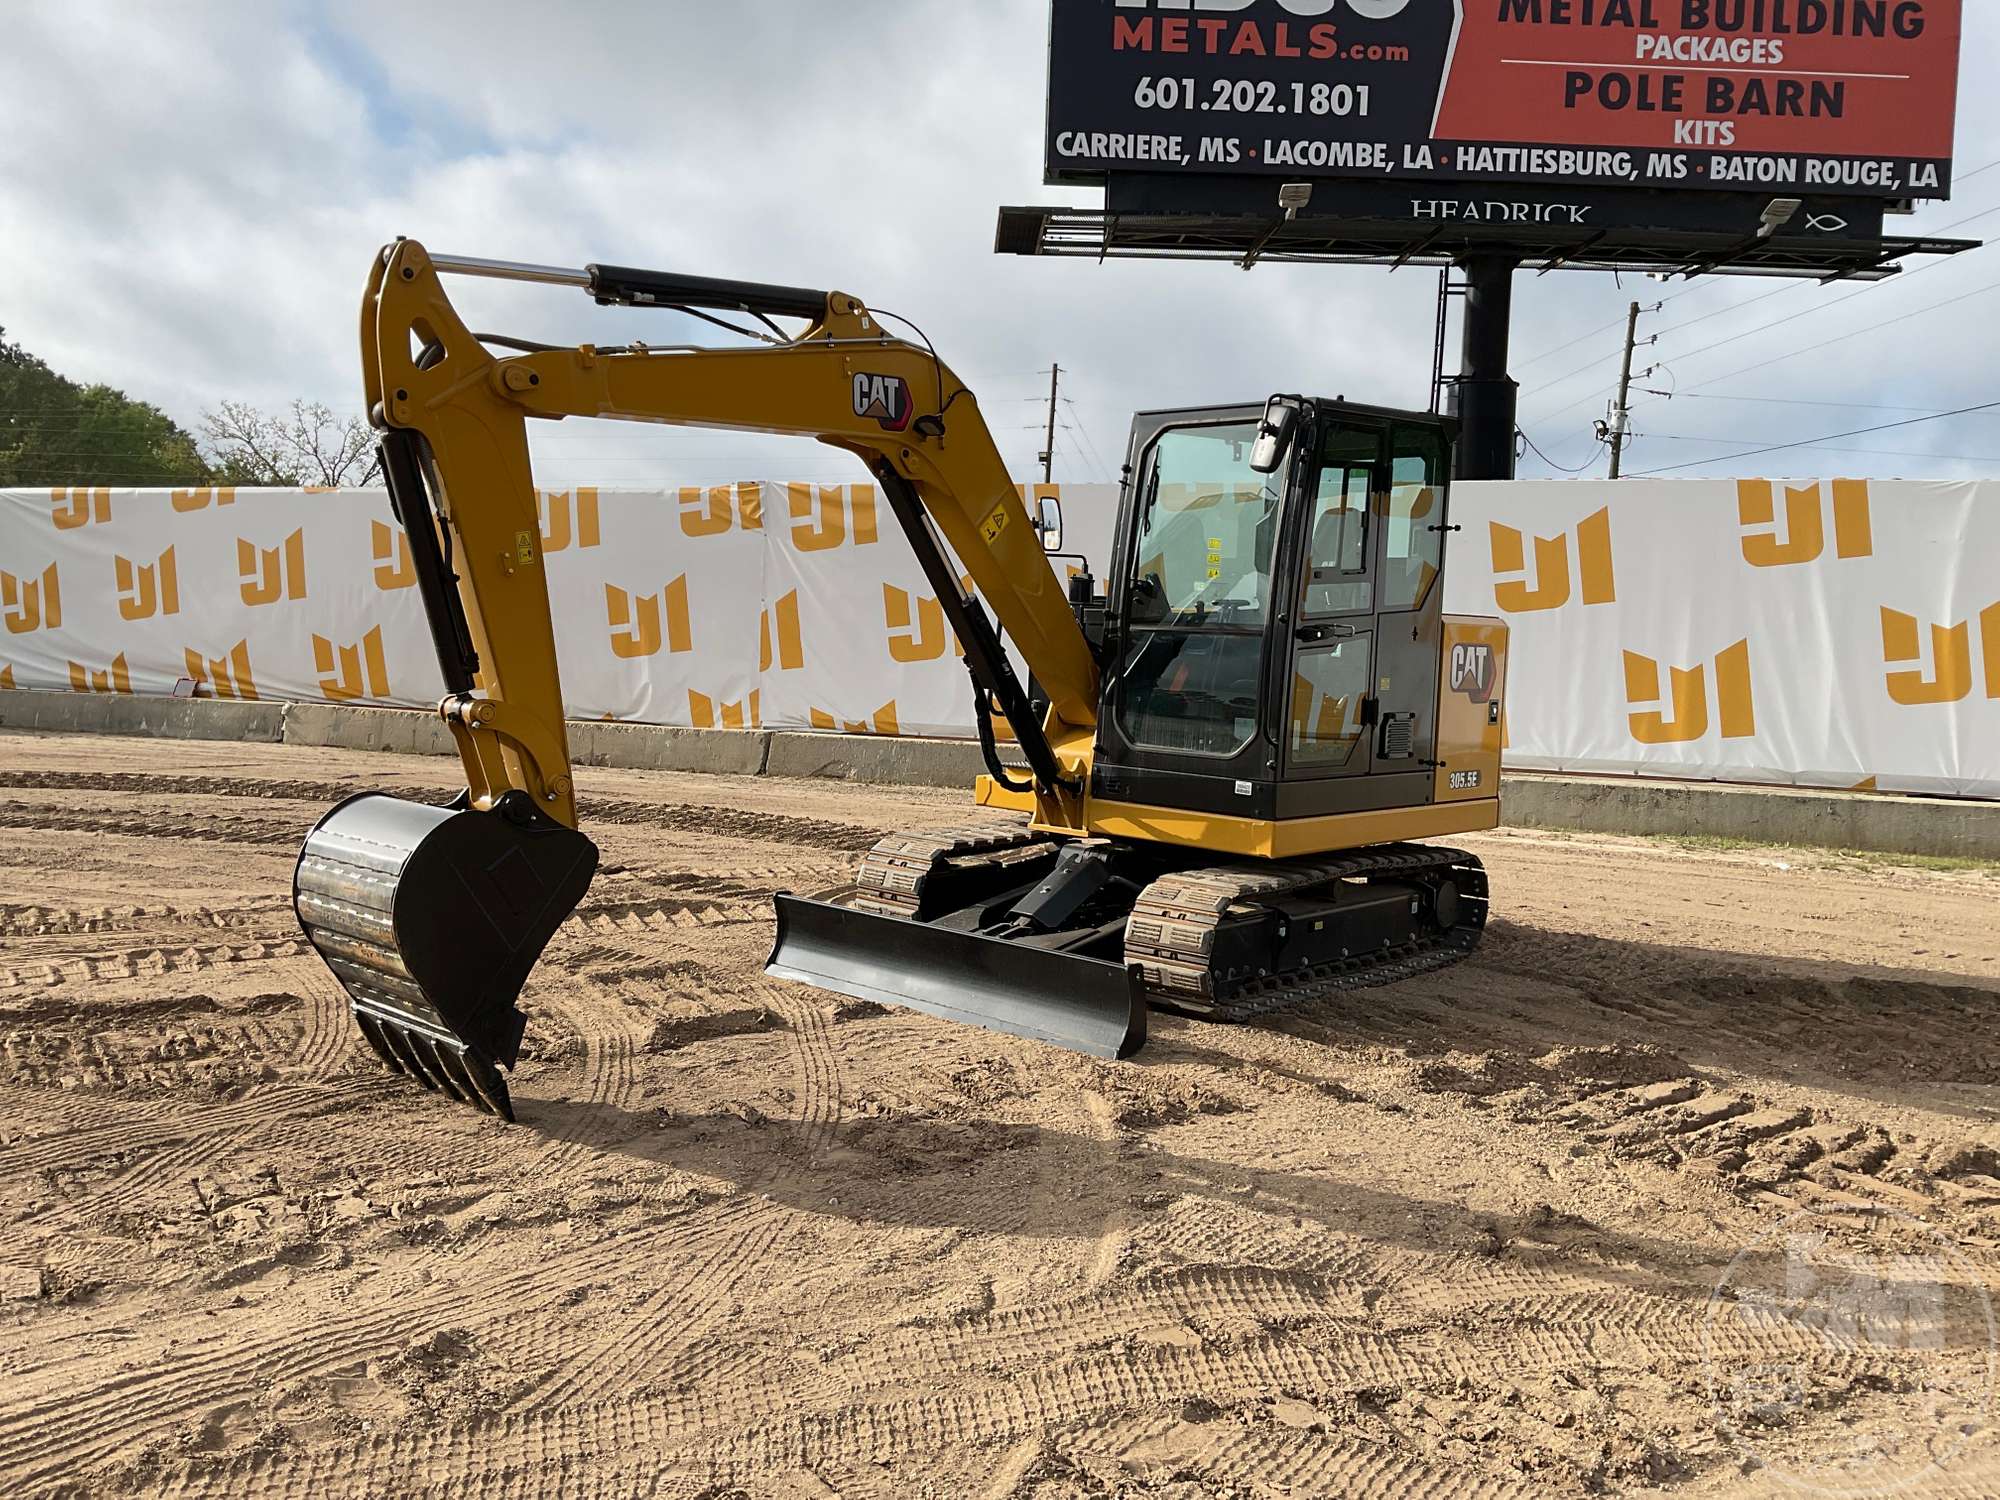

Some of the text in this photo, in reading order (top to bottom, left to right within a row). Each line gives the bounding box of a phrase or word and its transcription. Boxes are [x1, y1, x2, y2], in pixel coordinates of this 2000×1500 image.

[1681, 0, 1925, 38] BUILDING
[1636, 34, 1784, 64] PACKAGES
[1134, 76, 1369, 117] 601.202.1801
[1564, 71, 1845, 118] POLE BARN
[1674, 119, 1736, 146] KITS
[1055, 131, 1938, 191] CARRIERE, MS LACOMBE, LA HATTIESBURG, MS BATON ROUGE, LA
[1410, 199, 1592, 223] HEADRICK
[853, 373, 899, 418] CAT
[1452, 645, 1487, 689] CAT
[1449, 770, 1478, 790] 305.5E
